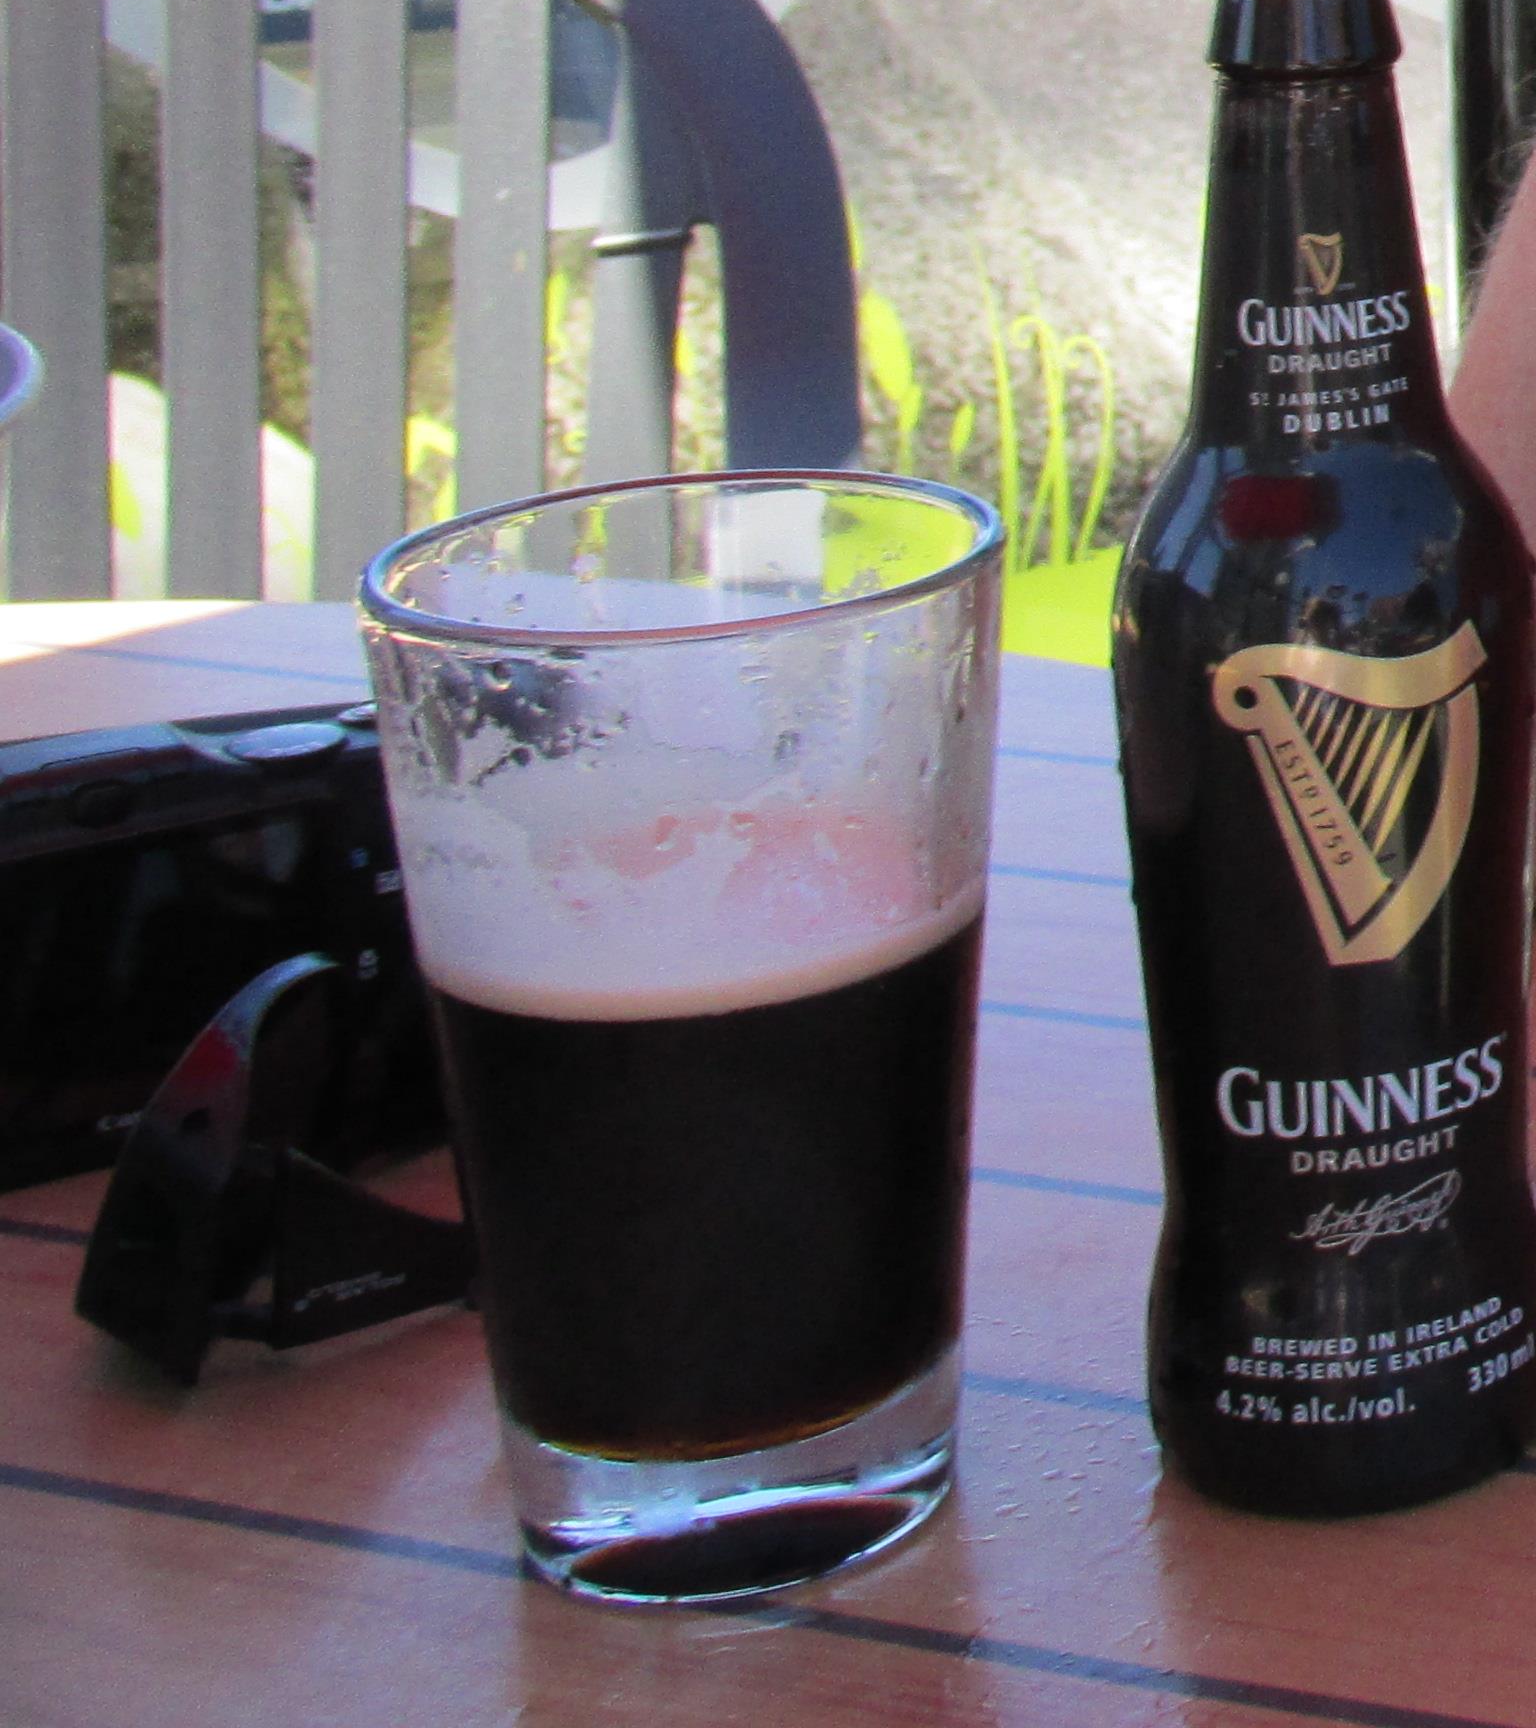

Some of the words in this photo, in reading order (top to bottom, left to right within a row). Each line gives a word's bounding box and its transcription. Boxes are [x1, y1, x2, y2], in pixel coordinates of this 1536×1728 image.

[1238, 291, 1410, 347] GUINNESS
[1267, 343, 1393, 373] DRAUGHT
[1368, 376, 1409, 398] GATE
[1283, 403, 1391, 434] DUBLIN
[1309, 808, 1353, 865] 1759
[1216, 1035, 1504, 1139] GUINNESS
[1290, 1125, 1459, 1174] DRAUGHT
[1224, 1354, 1378, 1381] BEER-SERVE
[1388, 1336, 1470, 1373] EXTRA
[1474, 1306, 1524, 1344] COLD
[1252, 1336, 1359, 1358] BREWED
[1368, 1331, 1398, 1352] IN
[1405, 1296, 1502, 1344] IRELAND
[1215, 1389, 1283, 1423] 4.2%
[1291, 1386, 1417, 1424] alc./vol.
